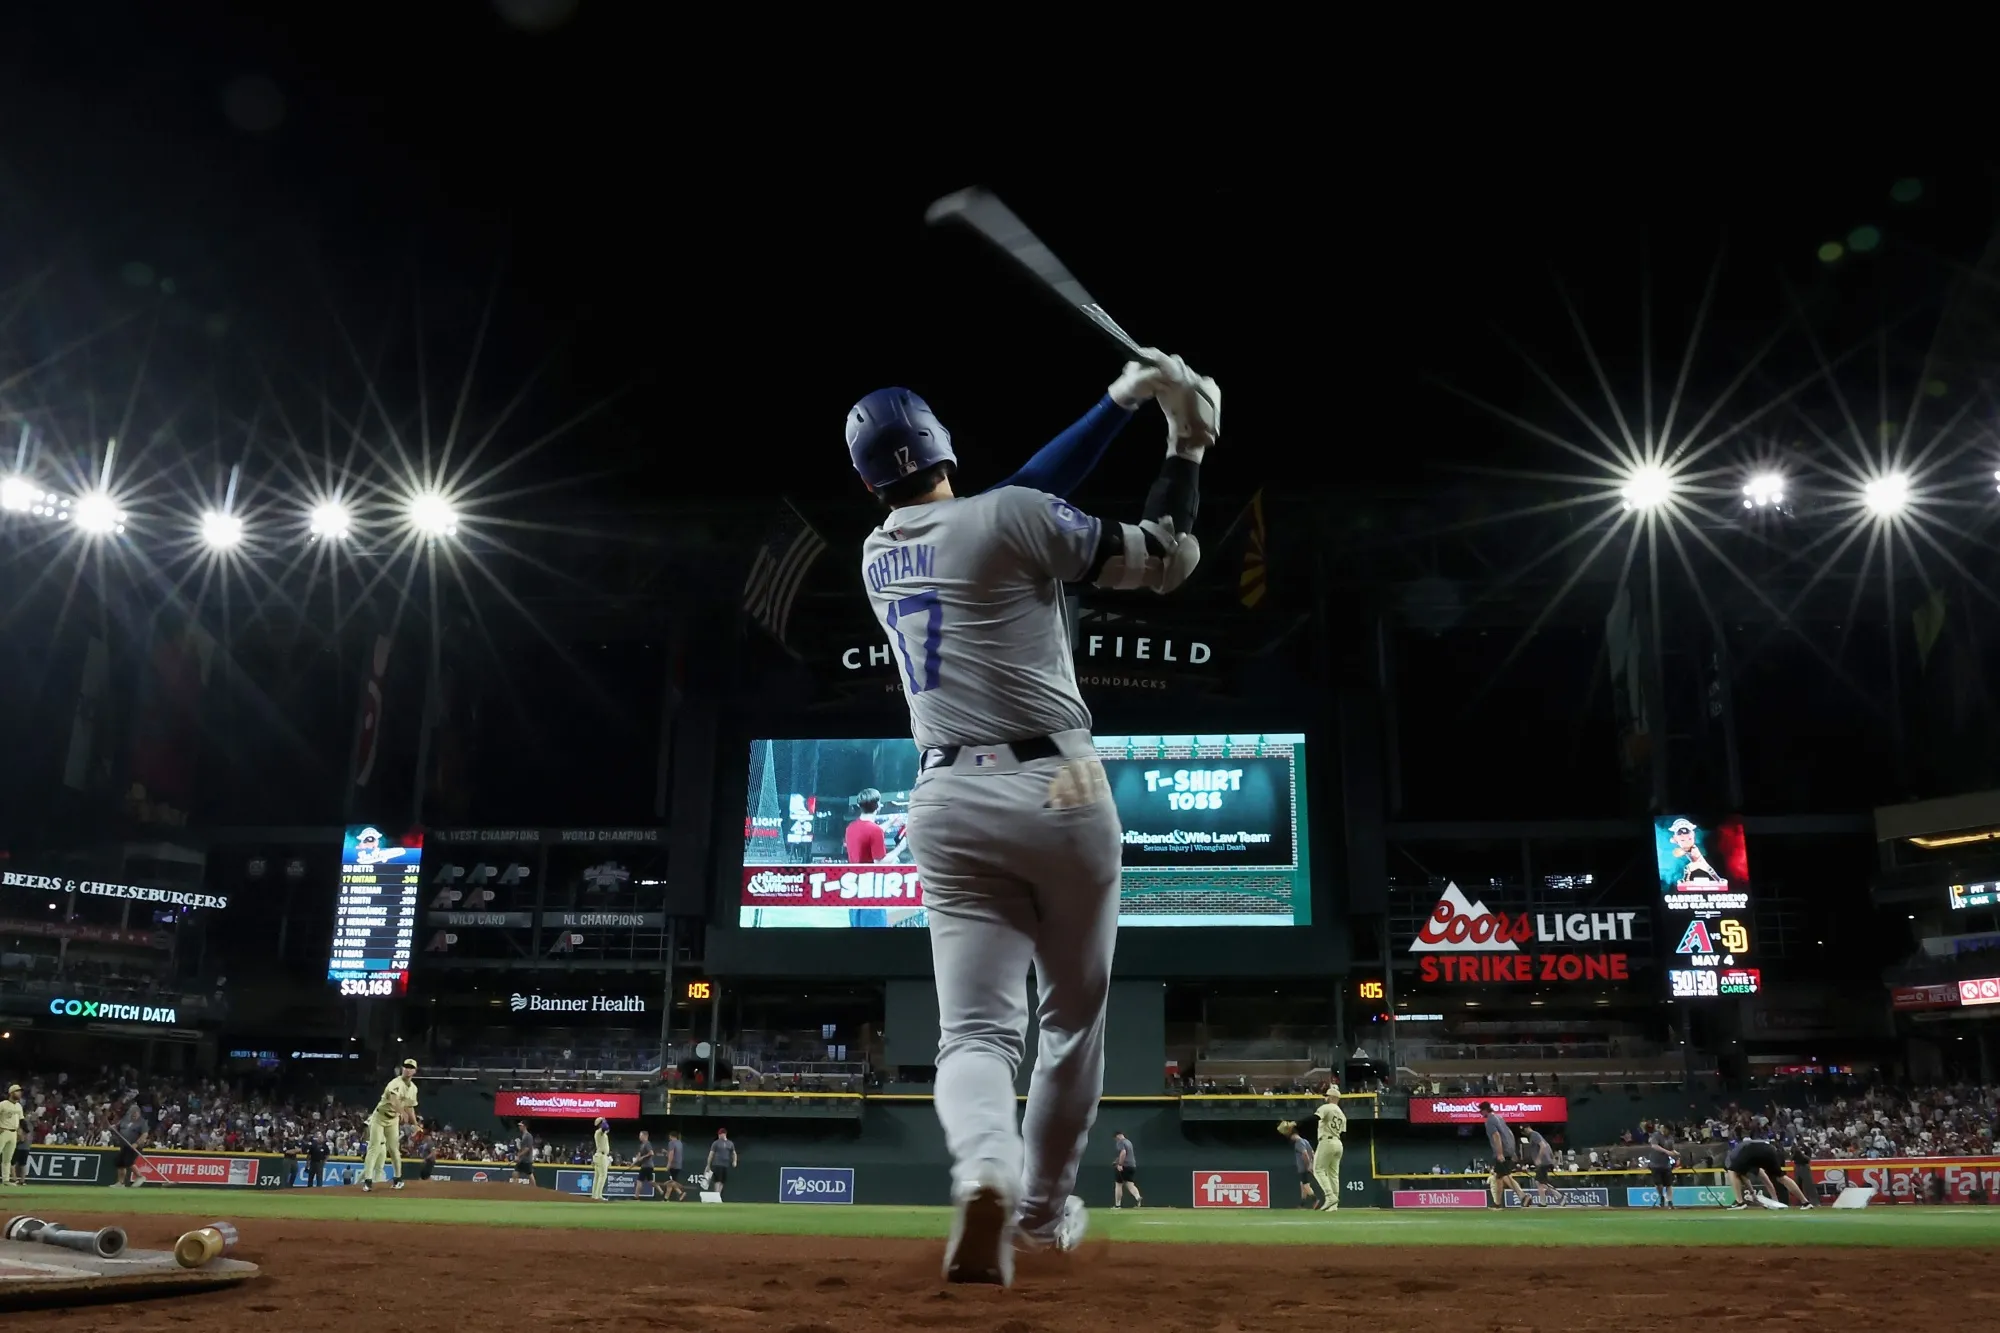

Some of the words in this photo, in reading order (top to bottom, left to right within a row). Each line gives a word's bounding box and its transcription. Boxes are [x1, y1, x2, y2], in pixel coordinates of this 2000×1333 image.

[893, 446, 909, 465] 17
[868, 545, 936, 593] OHTANI
[887, 589, 943, 696] 17
[1089, 635, 1212, 664] FIELD
[1079, 676, 1168, 690] MONDBACKS
[1144, 769, 1243, 792] T-SHIRT
[1168, 792, 1223, 811] TOSS
[481, 830, 540, 841] CHAMPIONS
[562, 830, 596, 841] WORLD
[598, 830, 658, 841] CHAMPIONS
[1212, 832, 1237, 843] Law
[1237, 832, 1270, 843] Team
[1169, 845, 1190, 853] Injury
[1194, 844, 1225, 853] Wrongful
[342, 875, 351, 883] 17
[809, 872, 919, 899] T-SHIRT
[2, 871, 63, 891] BEERS
[64, 879, 76, 893] &
[79, 880, 228, 909] CHEESEBURGERS
[448, 914, 475, 925] WILD
[477, 914, 506, 925] CARD
[563, 914, 577, 925] NL
[580, 914, 644, 926] CHAMPIONS
[1418, 900, 1535, 944] Coors
[1537, 912, 1636, 942] LIGHT
[1420, 955, 1533, 982] STRIKE
[1539, 954, 1629, 981] ZONE
[1692, 955, 1720, 966] MAY
[1723, 955, 1734, 965] 4
[340, 979, 392, 996] $30,168
[1720, 976, 1756, 985] AVNET
[688, 983, 710, 999] 1:05
[1360, 983, 1383, 999] 1:05
[1720, 985, 1749, 993] CARES
[50, 998, 99, 1017] COX
[99, 1003, 140, 1020] PITCH
[142, 1007, 176, 1023] DATA
[530, 995, 589, 1011] Banner
[592, 996, 645, 1012] Health
[578, 1099, 595, 1107] Law
[595, 1099, 617, 1108] Team
[1500, 1103, 1518, 1111] Law
[1518, 1103, 1542, 1111] Team
[1330, 1115, 1343, 1131] 53
[25, 1155, 86, 1178] NET
[157, 1164, 174, 1174] HIT
[176, 1164, 196, 1175] THE
[197, 1165, 225, 1176] BUDS
[260, 1176, 281, 1186] 374
[1346, 1181, 1364, 1191] 413
[1201, 1174, 1261, 1204] fry's
[1698, 1190, 1726, 1202] COX
[1428, 1193, 1460, 1205] Mobile
